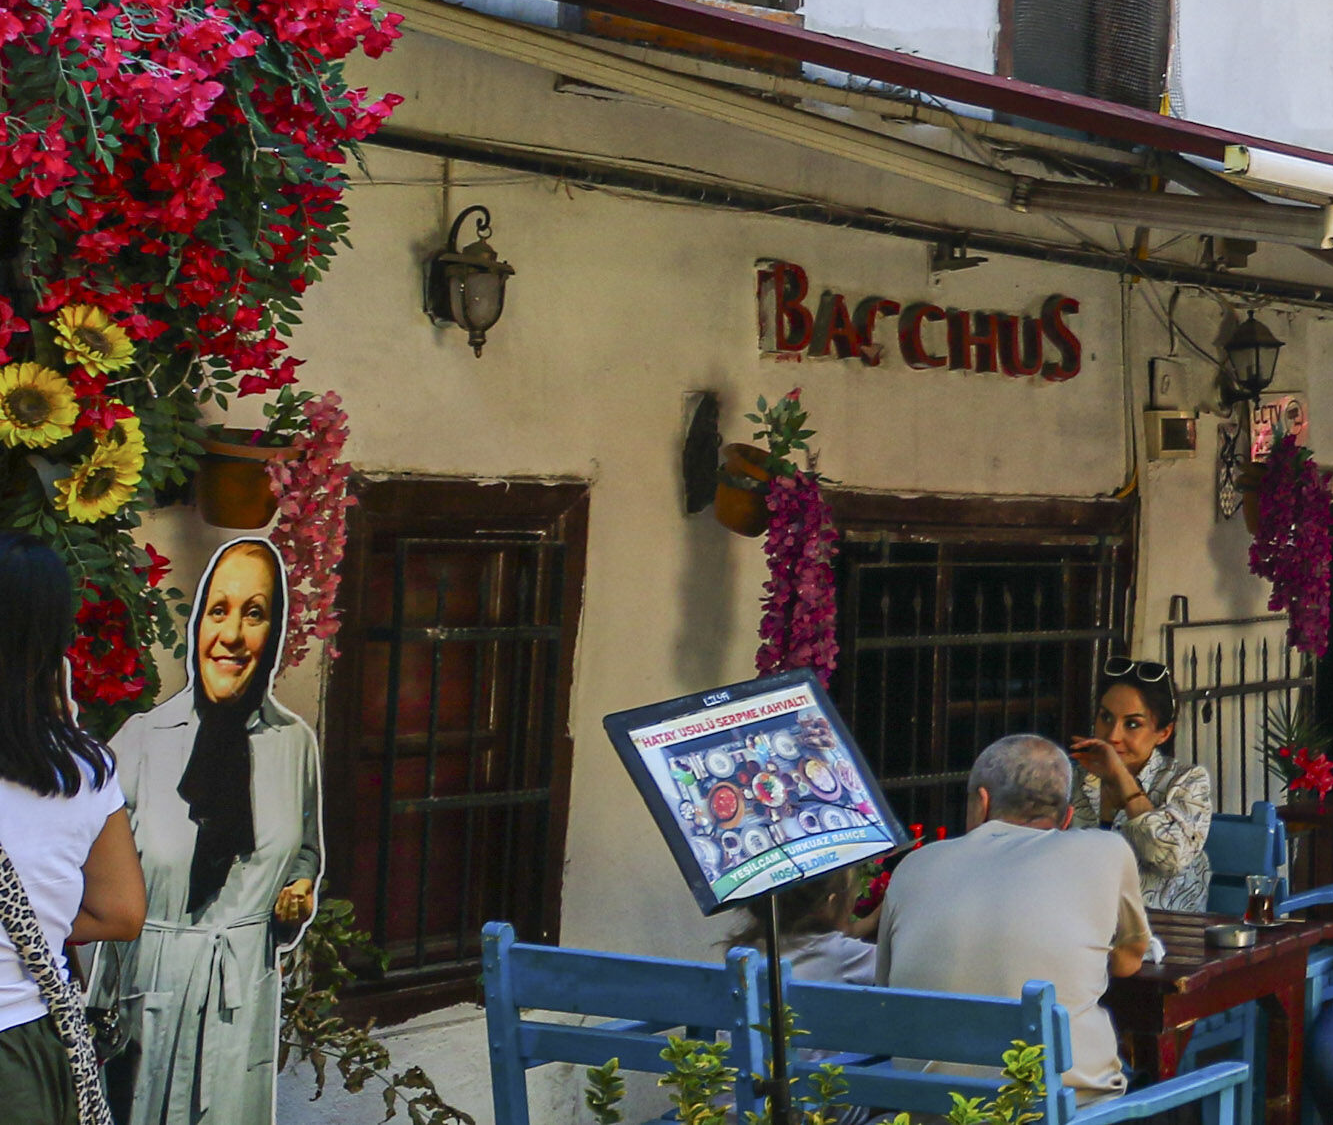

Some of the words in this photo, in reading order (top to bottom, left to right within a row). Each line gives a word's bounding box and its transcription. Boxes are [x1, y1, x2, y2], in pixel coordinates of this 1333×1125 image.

[755, 258, 1082, 382] BACCHUS
[1253, 404, 1282, 425] CCTV
[641, 729, 677, 748] HATAY
[679, 718, 715, 737] USULÜ
[715, 710, 758, 728] SERPME
[759, 695, 809, 716] KAHVALTI
